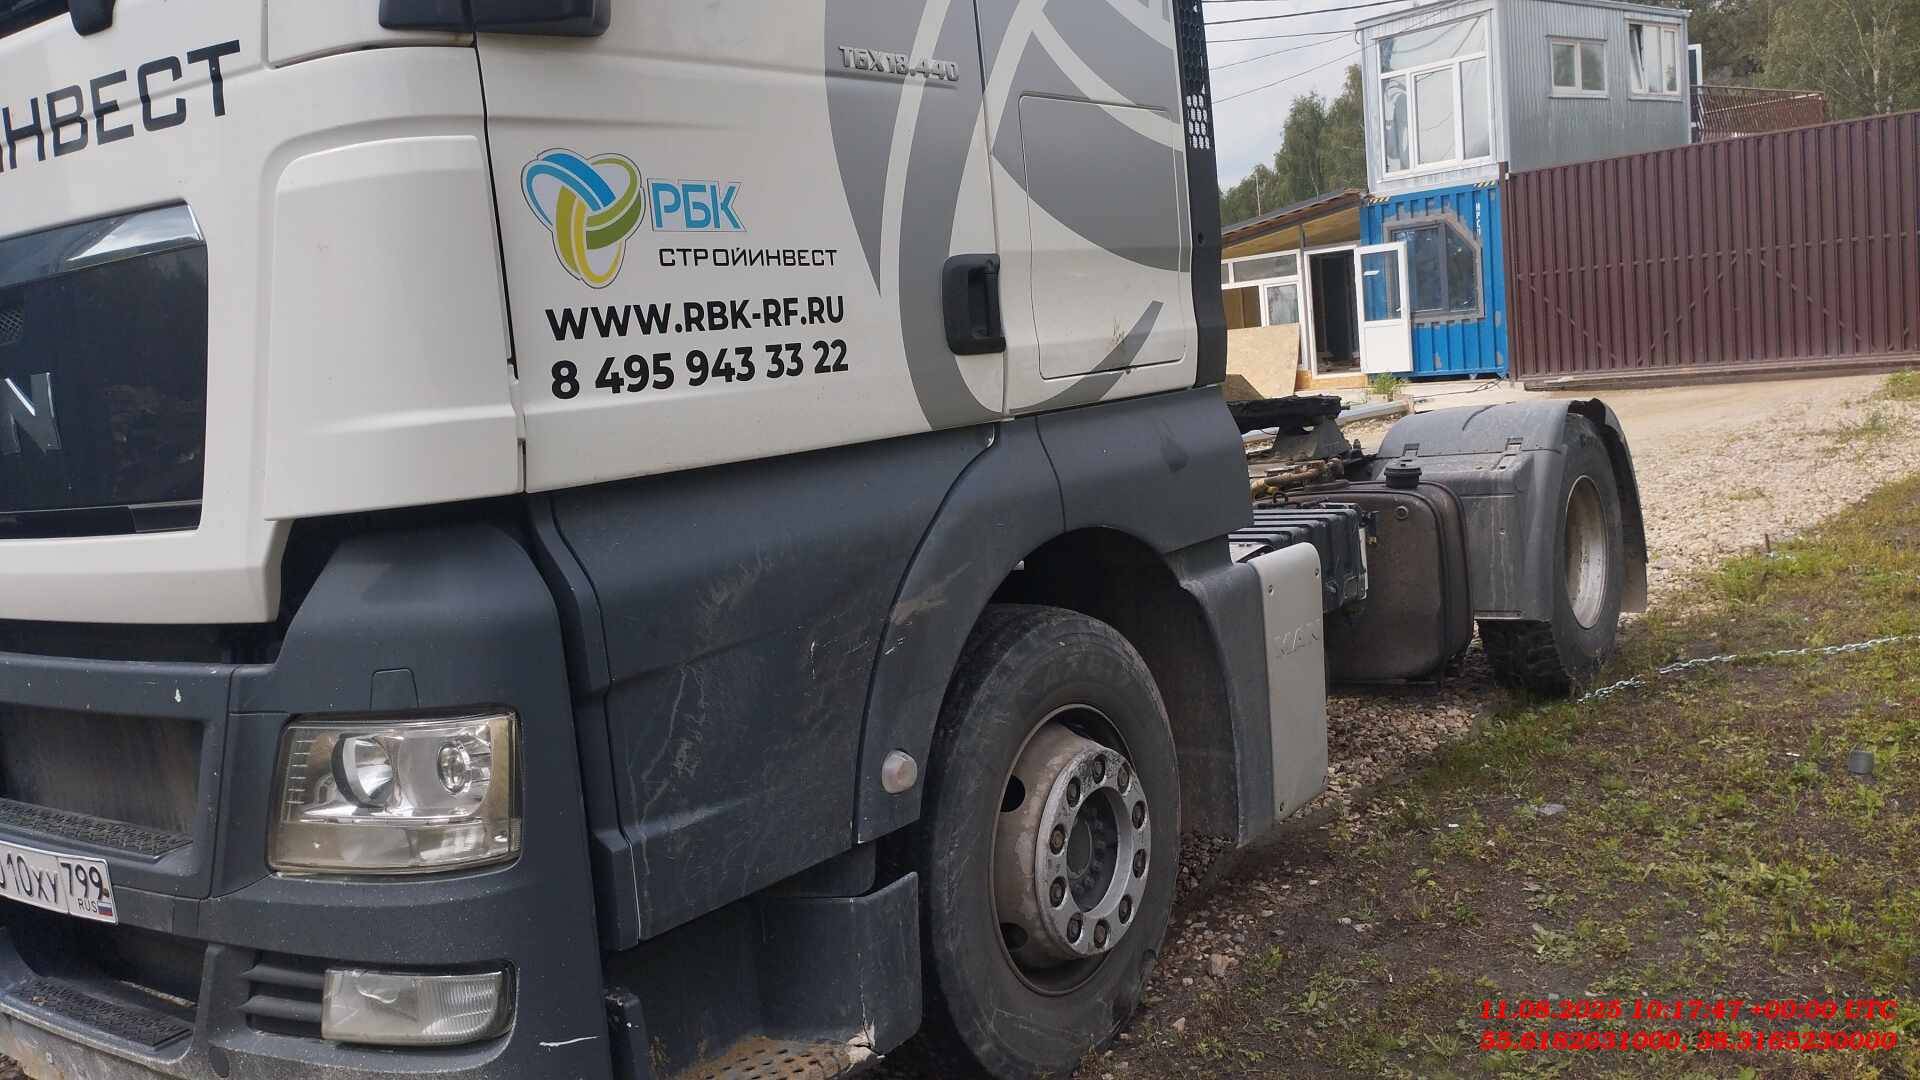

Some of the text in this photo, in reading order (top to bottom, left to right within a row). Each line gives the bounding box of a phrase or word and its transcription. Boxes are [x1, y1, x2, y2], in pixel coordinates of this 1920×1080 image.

[0, 39, 241, 172] НВЕСТ
[651, 182, 742, 229] РБК
[658, 247, 838, 267] СТРОЙИНВЕСТ
[545, 295, 845, 342] WWW.RBK-RF.RU
[551, 339, 849, 400] 8 495 943 33 22
[60, 862, 103, 900] 799
[77, 898, 98, 913] RUS
